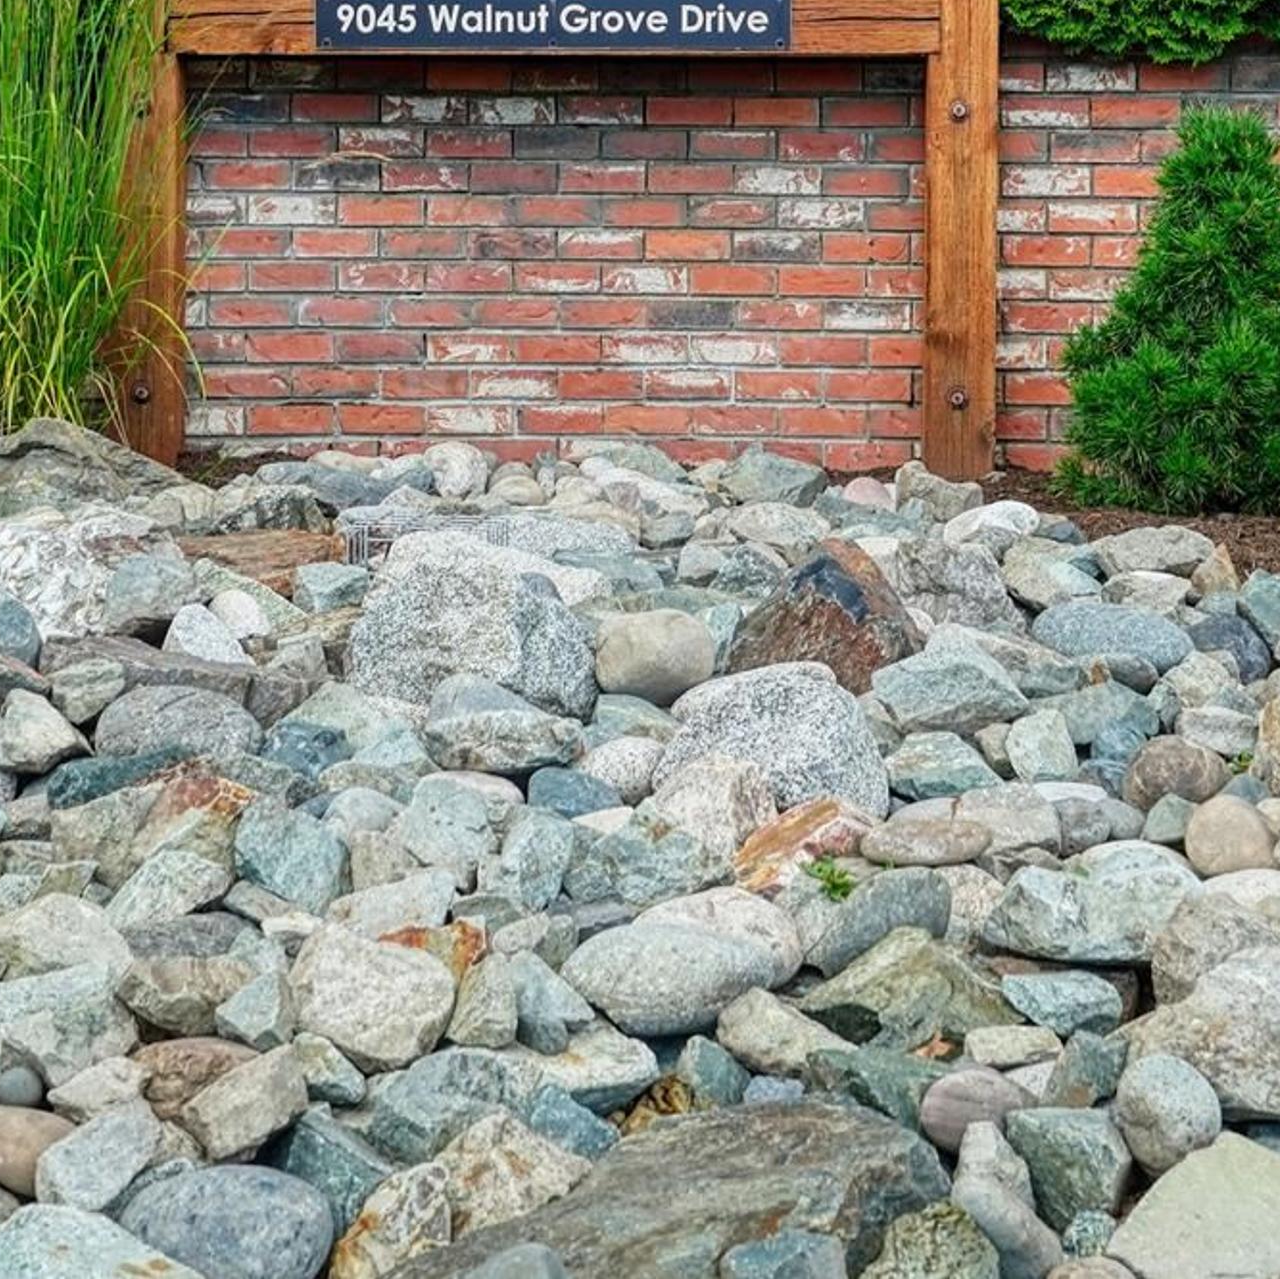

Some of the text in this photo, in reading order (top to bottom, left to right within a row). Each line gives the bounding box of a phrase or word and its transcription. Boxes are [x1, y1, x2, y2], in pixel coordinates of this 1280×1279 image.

[336, 4, 769, 34] 9045 Walnut Grove Drive
